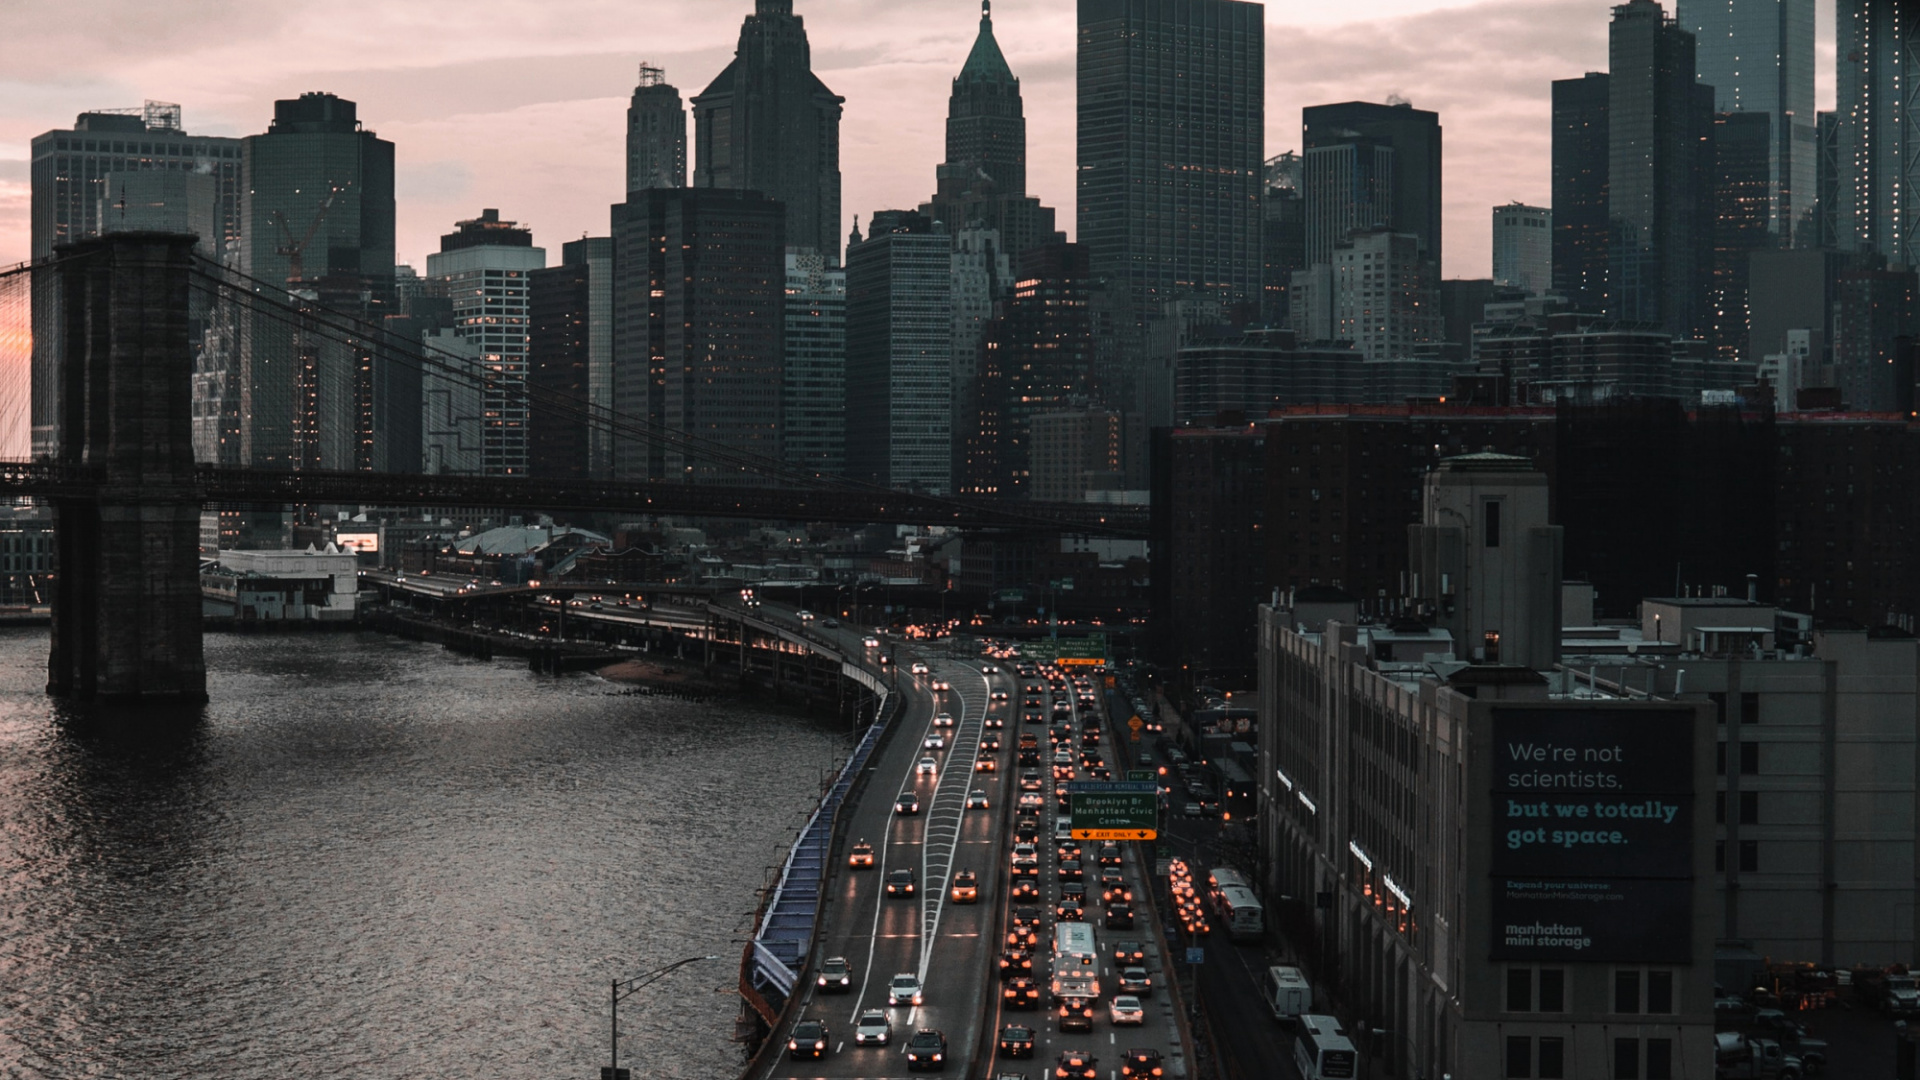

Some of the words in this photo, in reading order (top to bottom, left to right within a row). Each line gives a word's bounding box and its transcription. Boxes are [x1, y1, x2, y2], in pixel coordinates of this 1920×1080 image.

[1508, 743, 1576, 761] We're
[1585, 745, 1623, 762] not
[1508, 770, 1623, 789] scientists,
[1507, 800, 1550, 817] but
[1554, 804, 1589, 818] we
[1594, 801, 1678, 824] totally
[1507, 827, 1546, 849] got
[1552, 830, 1629, 848] space.
[1507, 880, 1542, 890] Expand
[1568, 882, 1611, 890] universe:
[1507, 891, 1624, 902] ManhattanMiniStorage.com
[1505, 921, 1582, 936] manhattan
[1505, 935, 1534, 946] mini
[1537, 936, 1591, 950] storage
